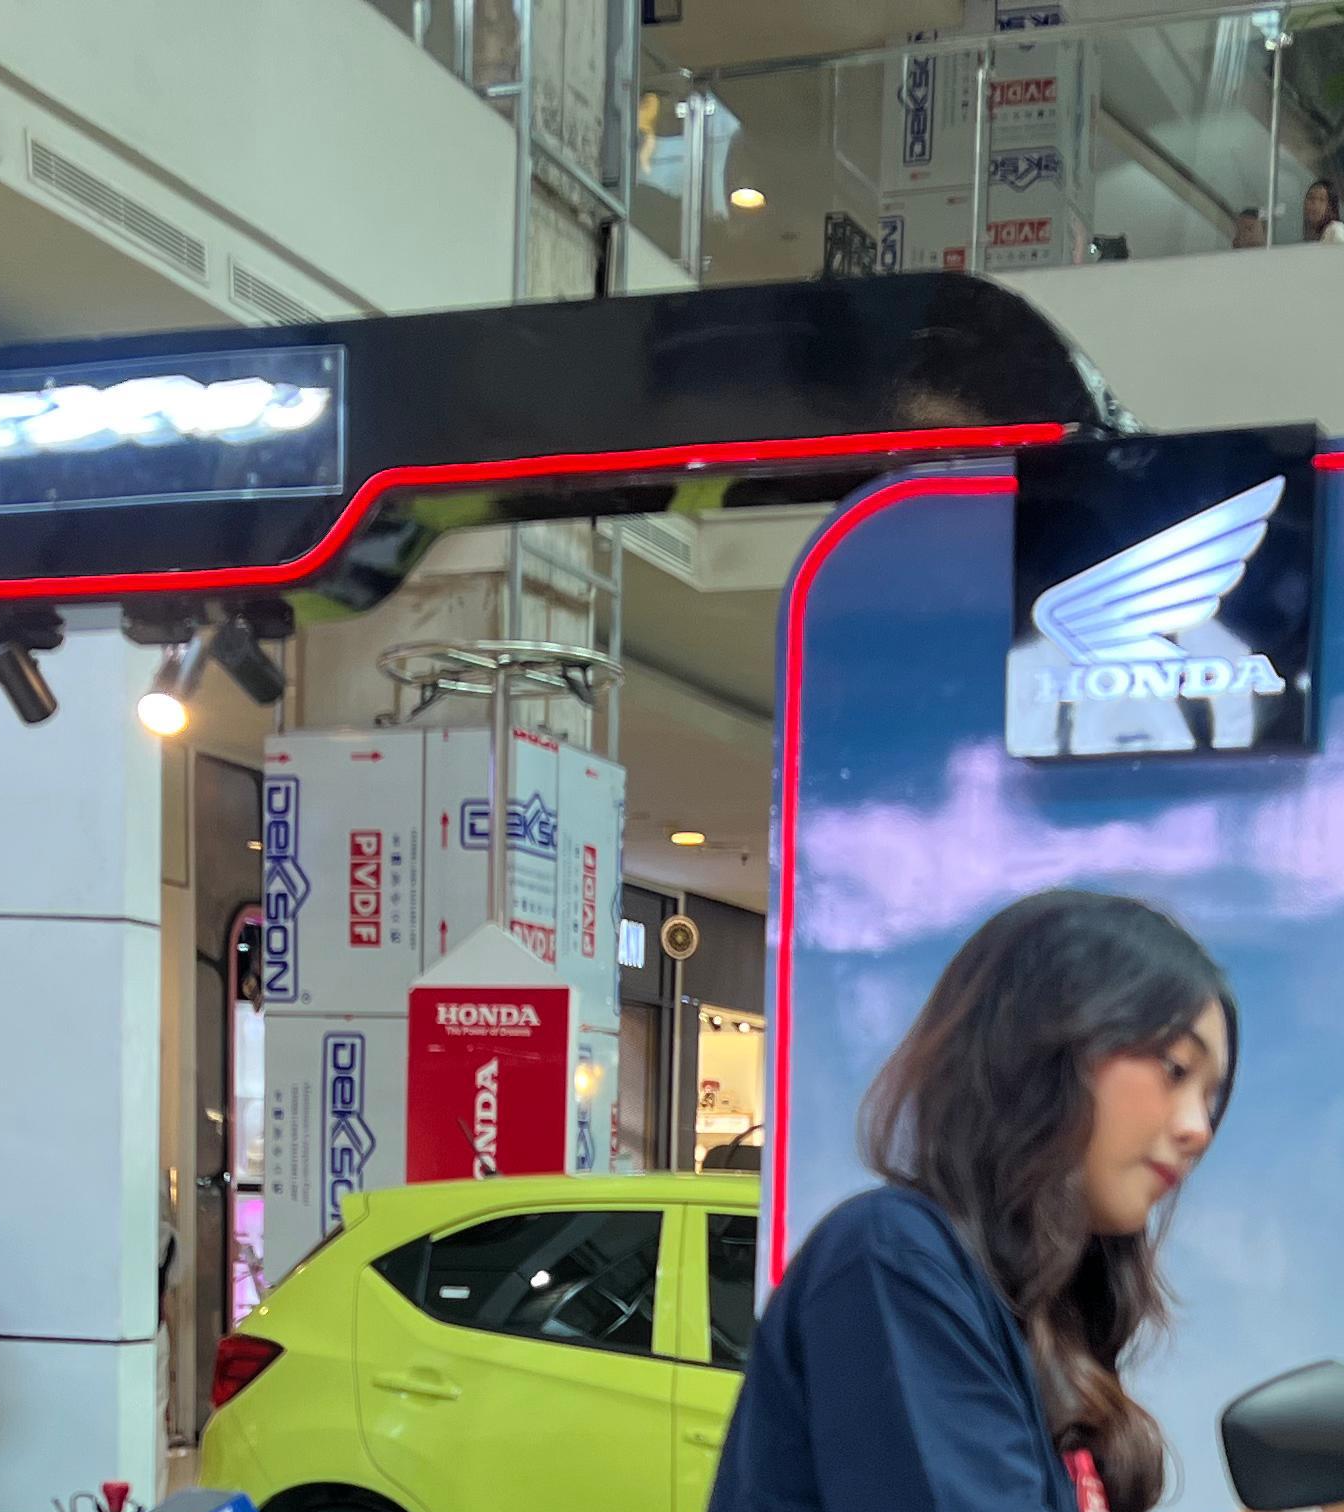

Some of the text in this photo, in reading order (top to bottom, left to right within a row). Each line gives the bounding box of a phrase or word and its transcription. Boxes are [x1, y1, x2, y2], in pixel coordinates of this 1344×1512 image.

[1033, 654, 1287, 702] HONDA
[354, 835, 379, 945] PVDF
[436, 1003, 542, 1027] HONDA
[473, 1056, 499, 1181] ONDA
